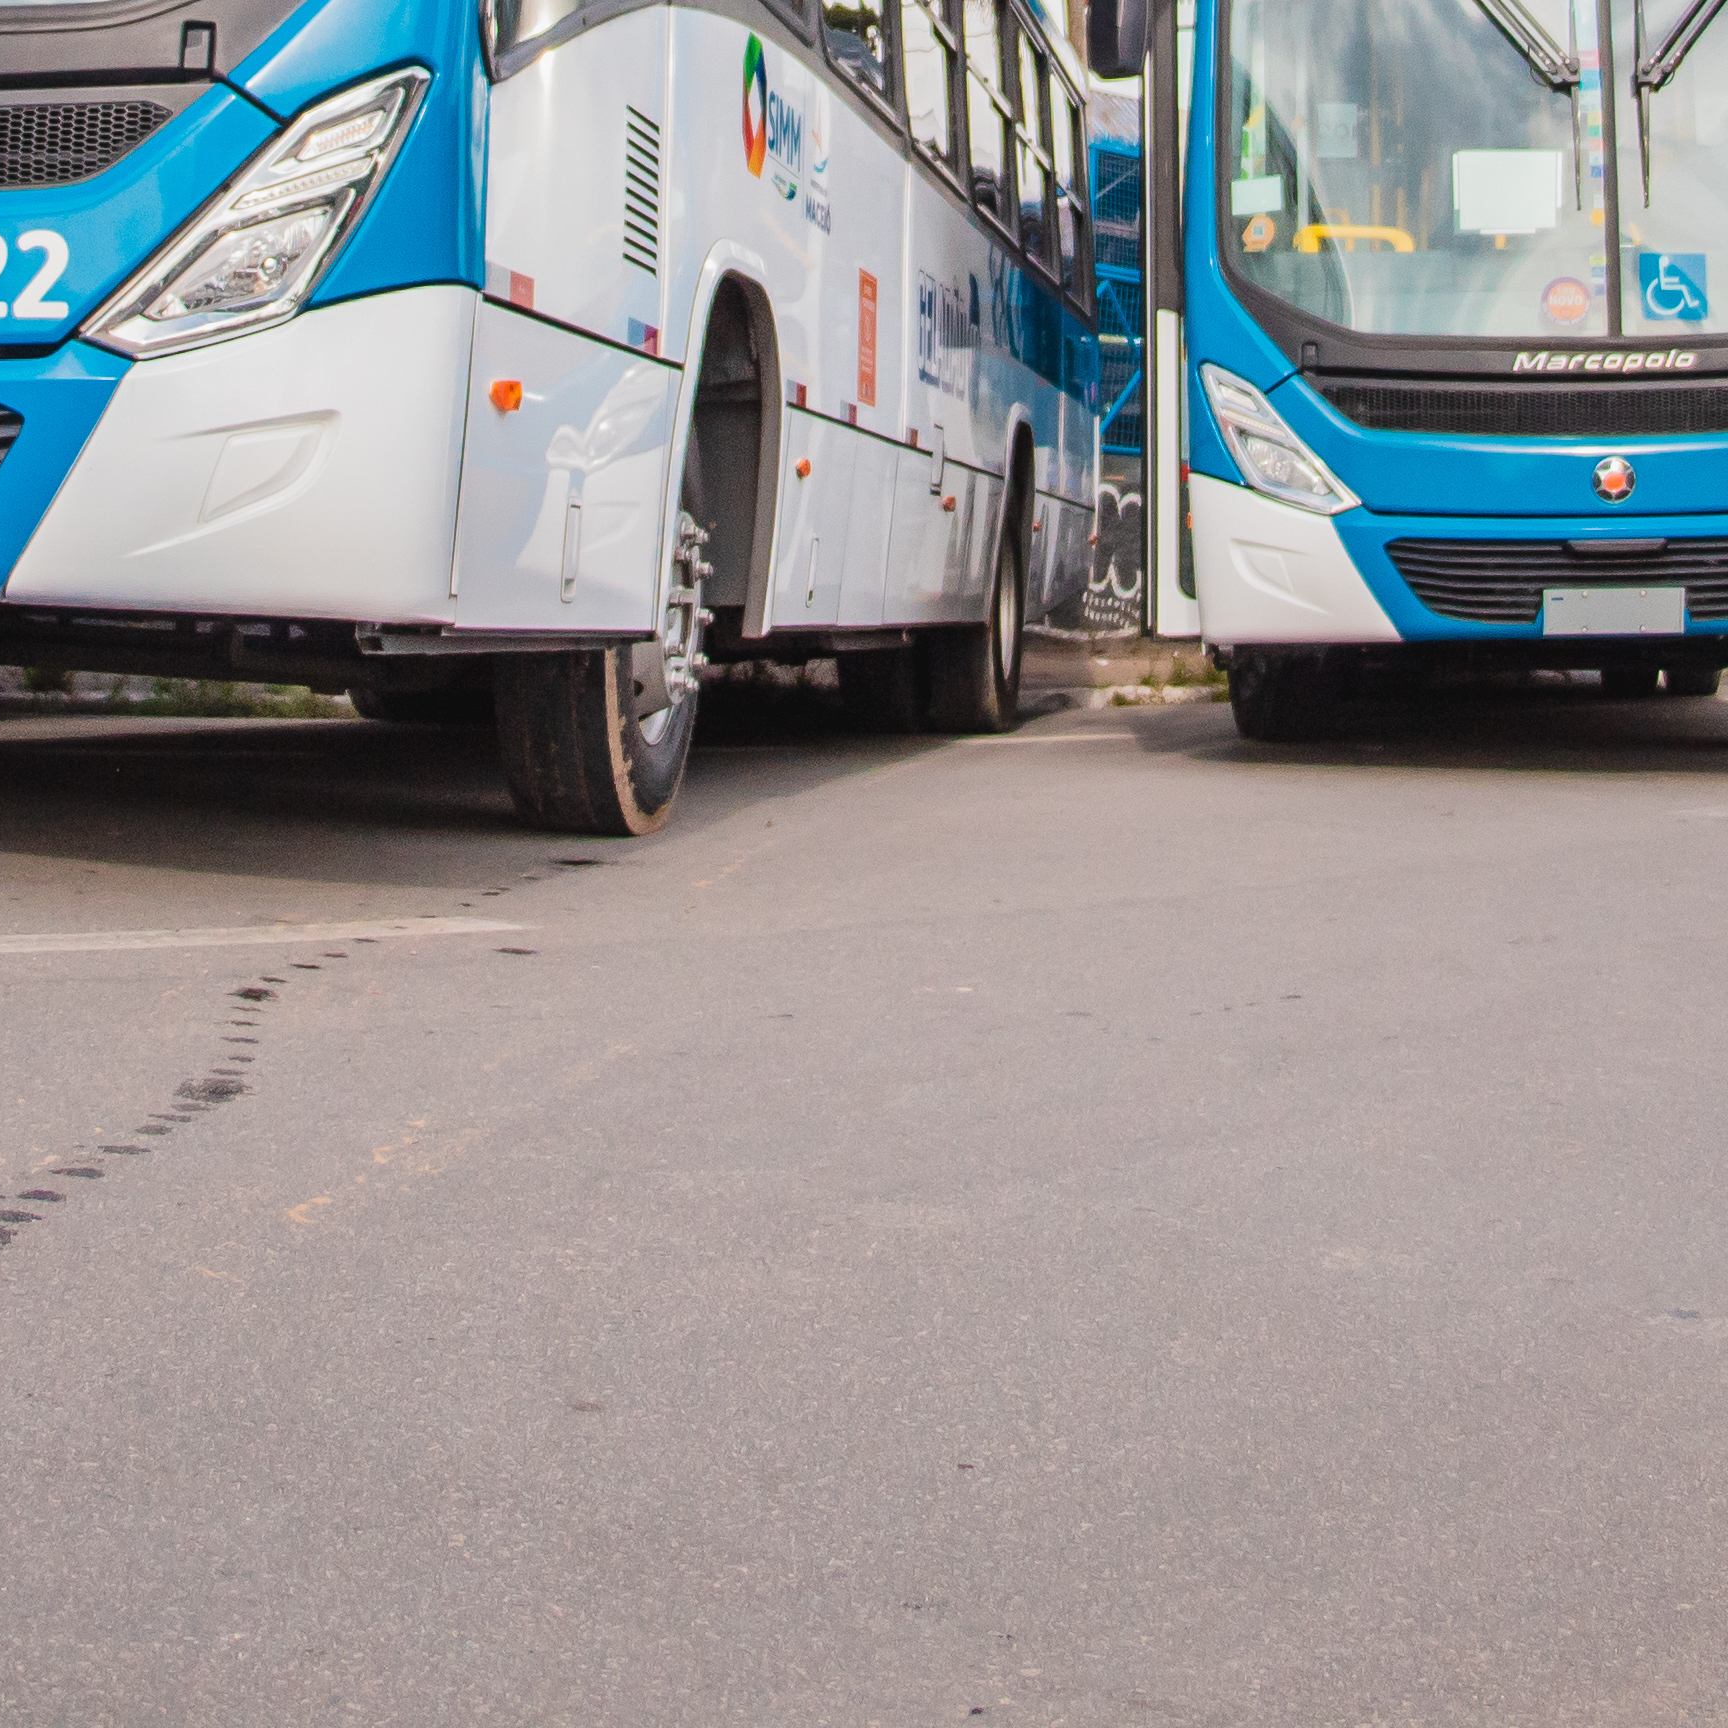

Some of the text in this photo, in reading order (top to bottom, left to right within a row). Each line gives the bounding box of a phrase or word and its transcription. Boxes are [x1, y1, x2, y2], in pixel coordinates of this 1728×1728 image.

[767, 90, 802, 173] SIMM
[1549, 294, 1584, 306] NOVO
[1513, 349, 1697, 373] Marcopolo
